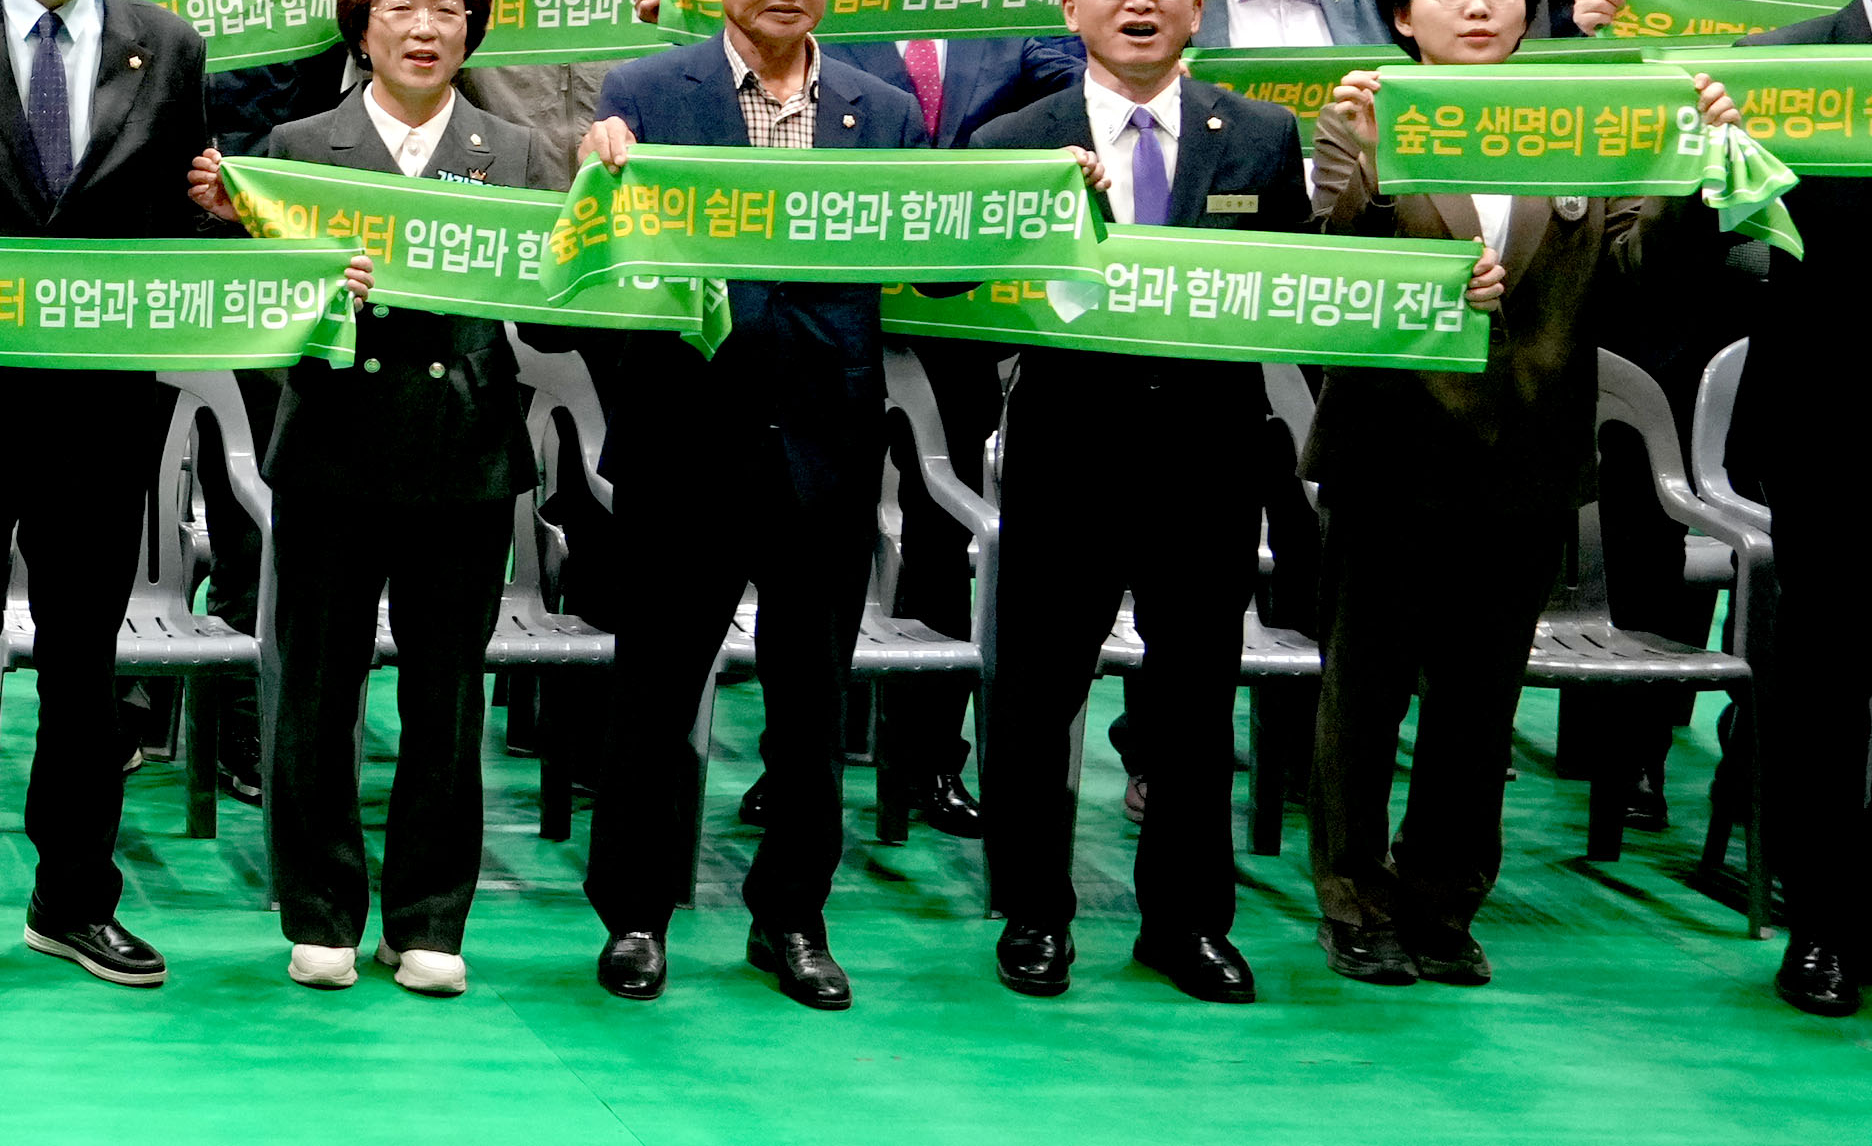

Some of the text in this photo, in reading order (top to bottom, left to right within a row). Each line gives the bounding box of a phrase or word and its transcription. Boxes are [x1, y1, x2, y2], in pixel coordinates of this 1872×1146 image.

[1393, 104, 1665, 156] 숲은 생명의 쉼터
[704, 189, 1084, 242] 쉼터 임업과 함께 희망의
[405, 218, 509, 278] 임업과
[36, 278, 138, 330] 임업과
[146, 278, 214, 330] 함께
[223, 277, 325, 330] 희망의
[1186, 266, 1467, 334] 함께 희망의 전남
